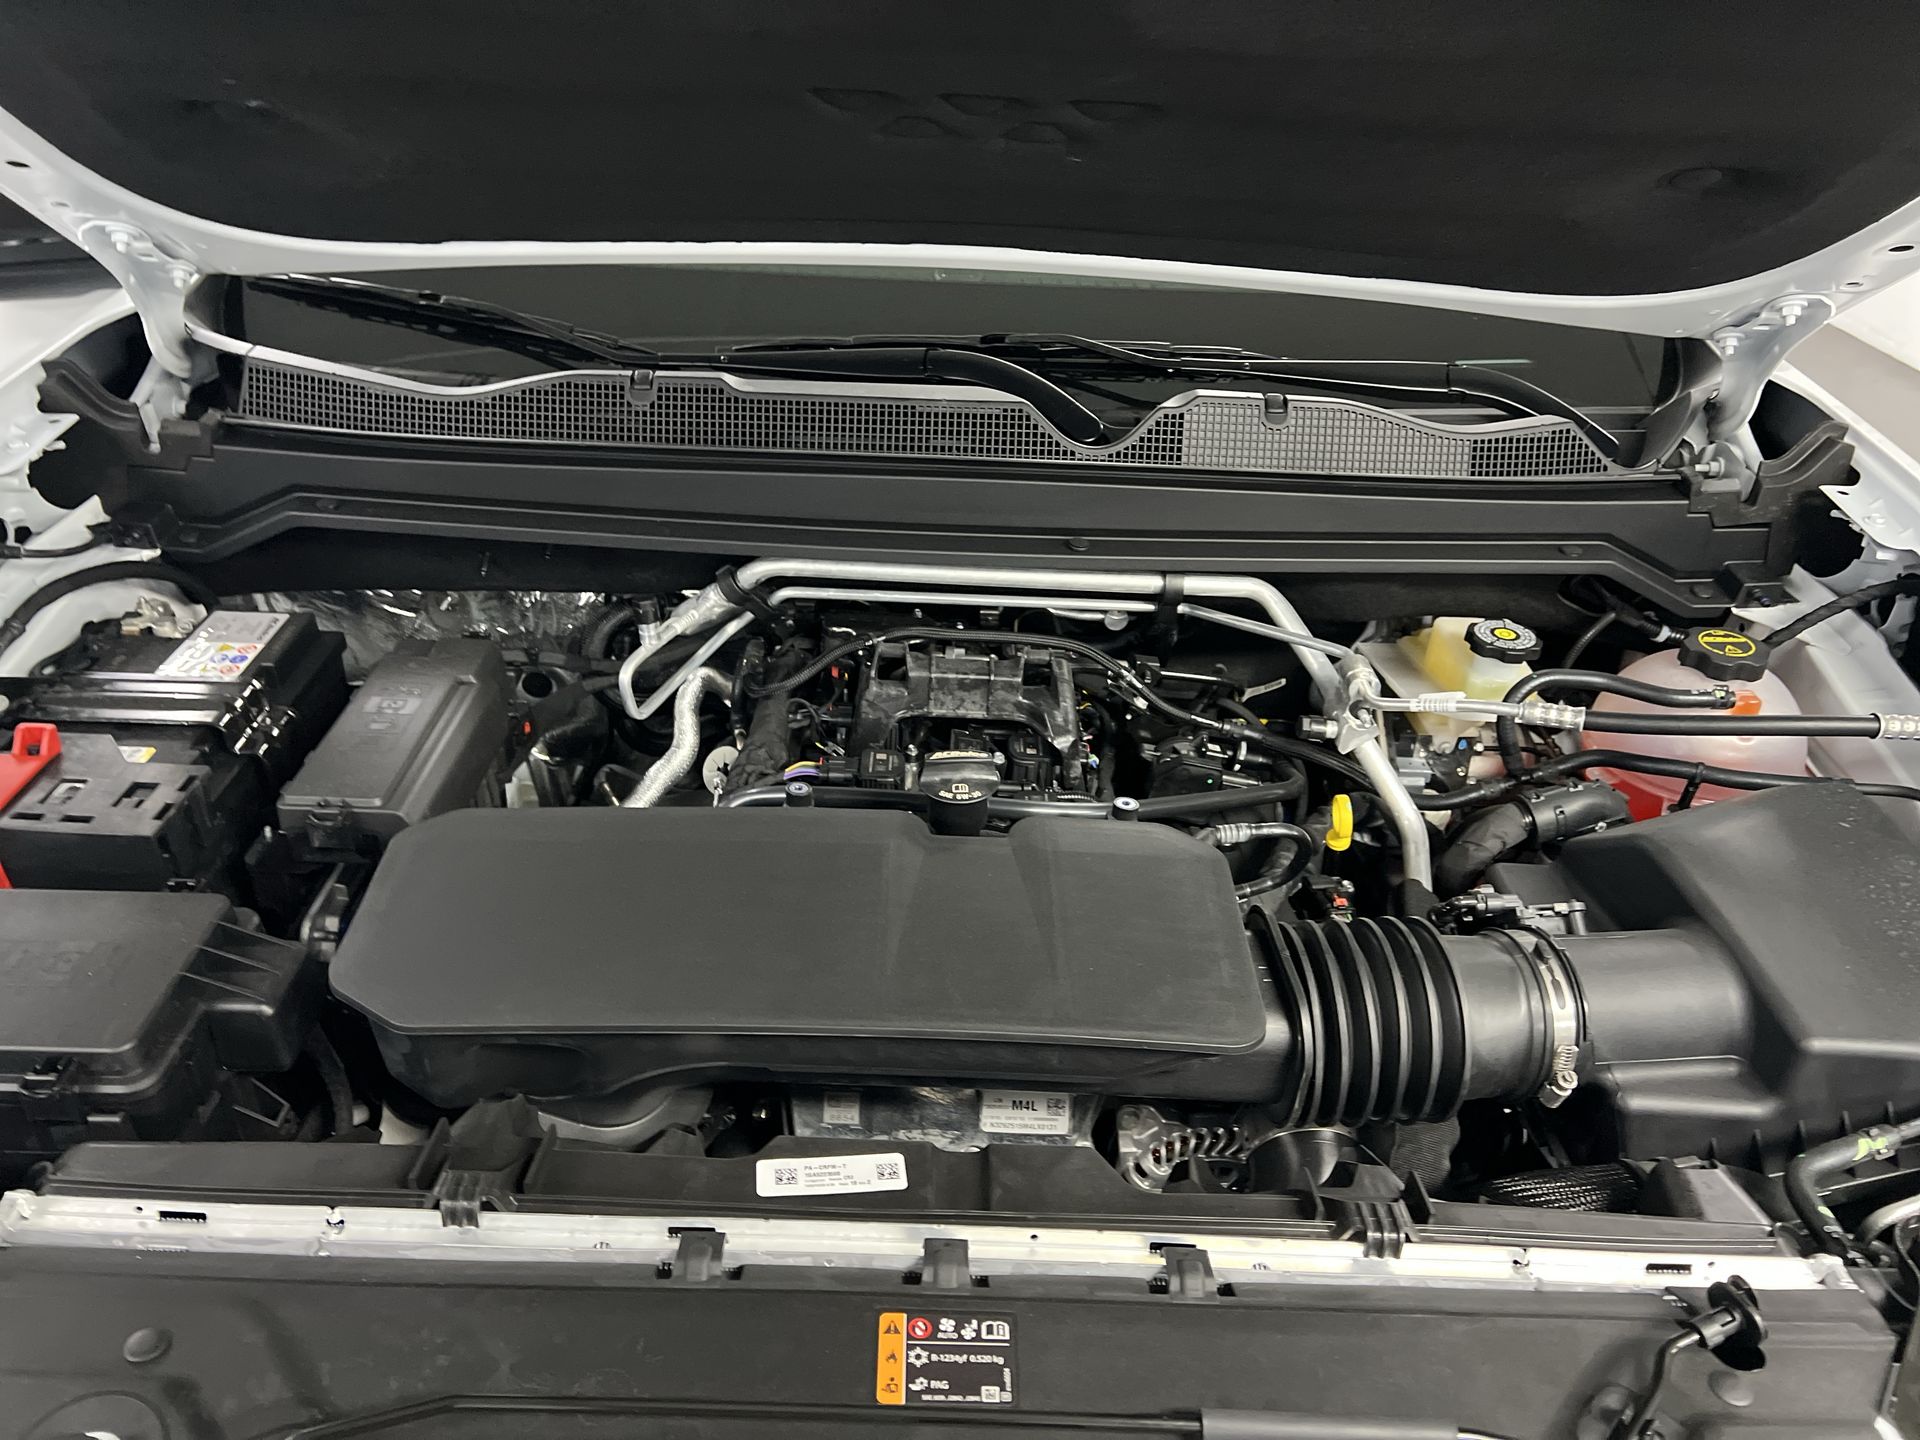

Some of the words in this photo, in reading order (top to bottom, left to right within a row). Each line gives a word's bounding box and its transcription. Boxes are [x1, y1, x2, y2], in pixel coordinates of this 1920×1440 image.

[938, 790, 954, 799] SAE
[1012, 1100, 1038, 1112] M4L
[930, 1380, 950, 1390] PAG
